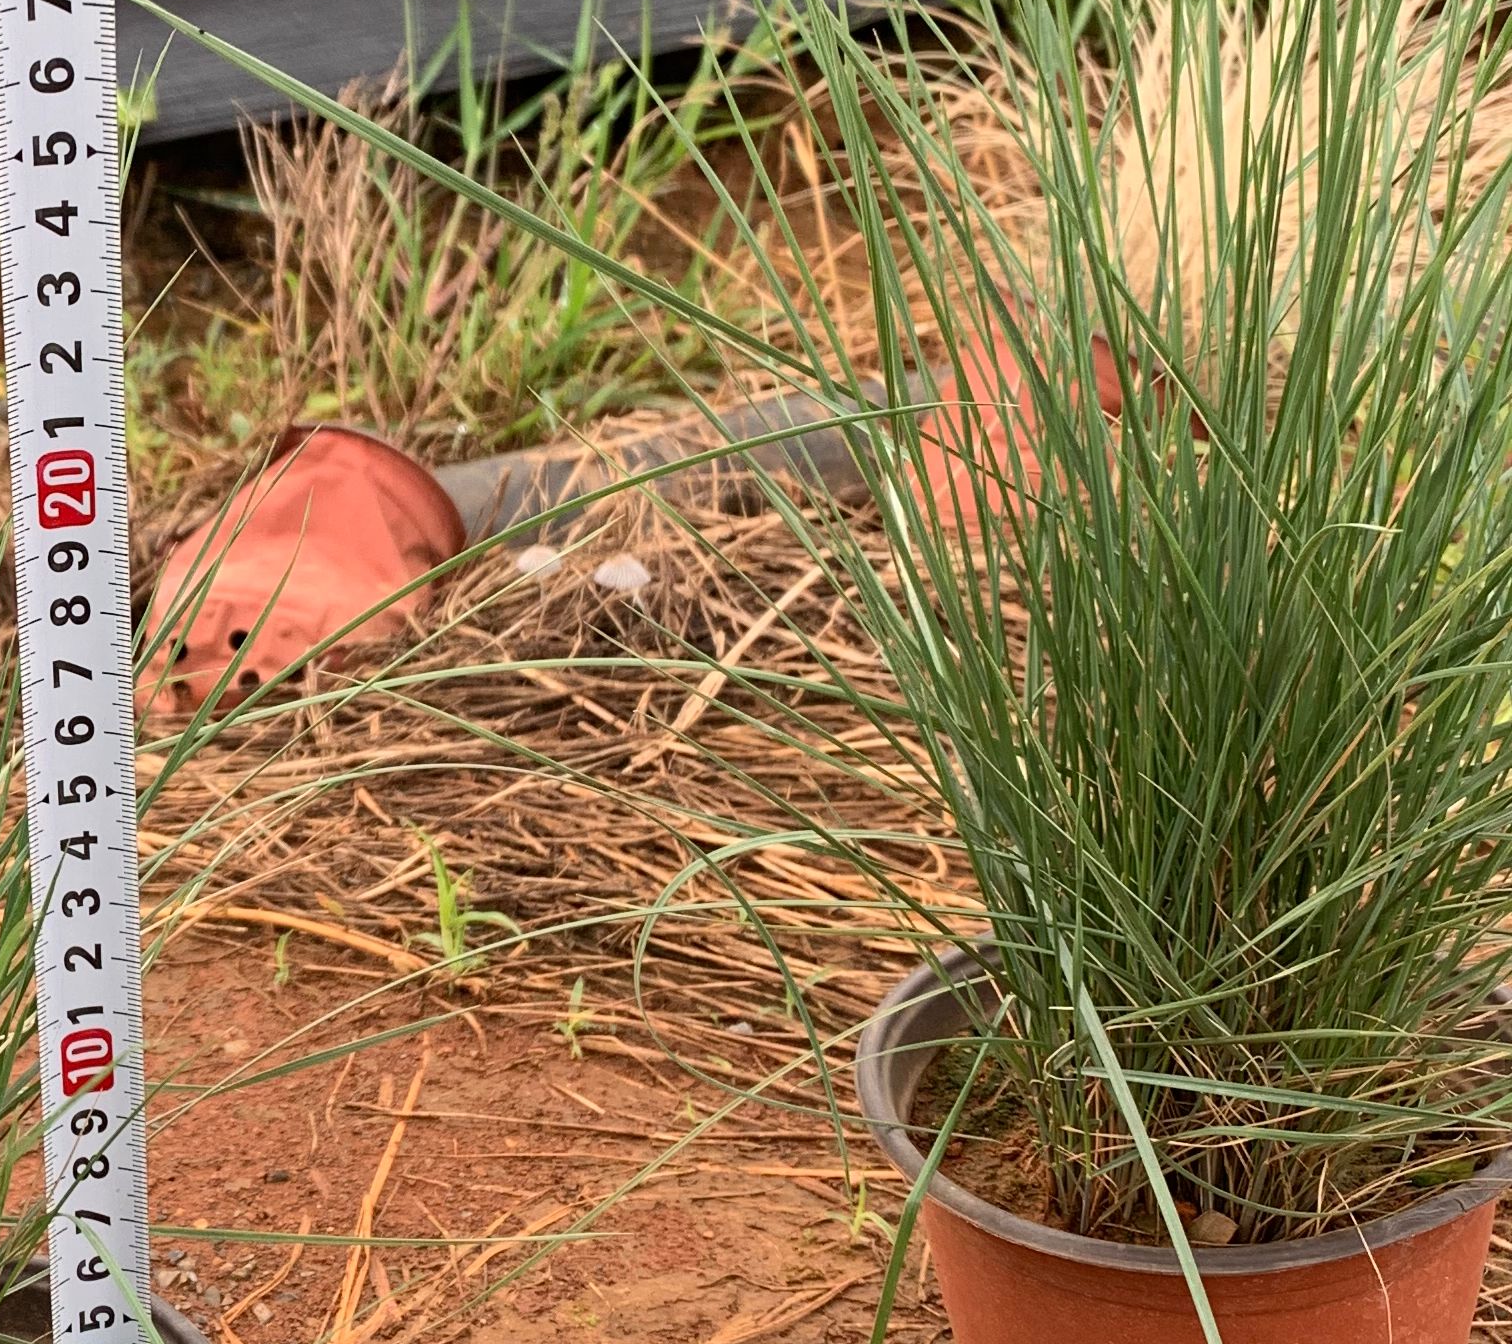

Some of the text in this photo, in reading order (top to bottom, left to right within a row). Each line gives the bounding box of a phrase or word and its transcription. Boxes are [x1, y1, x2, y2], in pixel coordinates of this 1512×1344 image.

[29, 57, 75, 94] 6
[32, 131, 77, 167] 5
[35, 199, 78, 237] 4
[36, 271, 81, 307] 3
[39, 340, 83, 374] 2
[42, 416, 85, 439] 1
[43, 460, 92, 517] 20
[47, 540, 90, 573] 9
[49, 595, 91, 627] 8
[52, 659, 93, 689] 7
[54, 715, 95, 746] 6
[57, 775, 97, 806] 5
[60, 830, 98, 861] 4
[61, 887, 101, 918] 3
[63, 943, 103, 973] 2
[66, 1005, 104, 1025] 1
[65, 1036, 110, 1085] 10
[70, 1108, 109, 1137] 9
[72, 1153, 110, 1182] 8
[74, 1209, 112, 1235] 7
[76, 1255, 111, 1282] 6
[79, 1305, 115, 1333] 5
